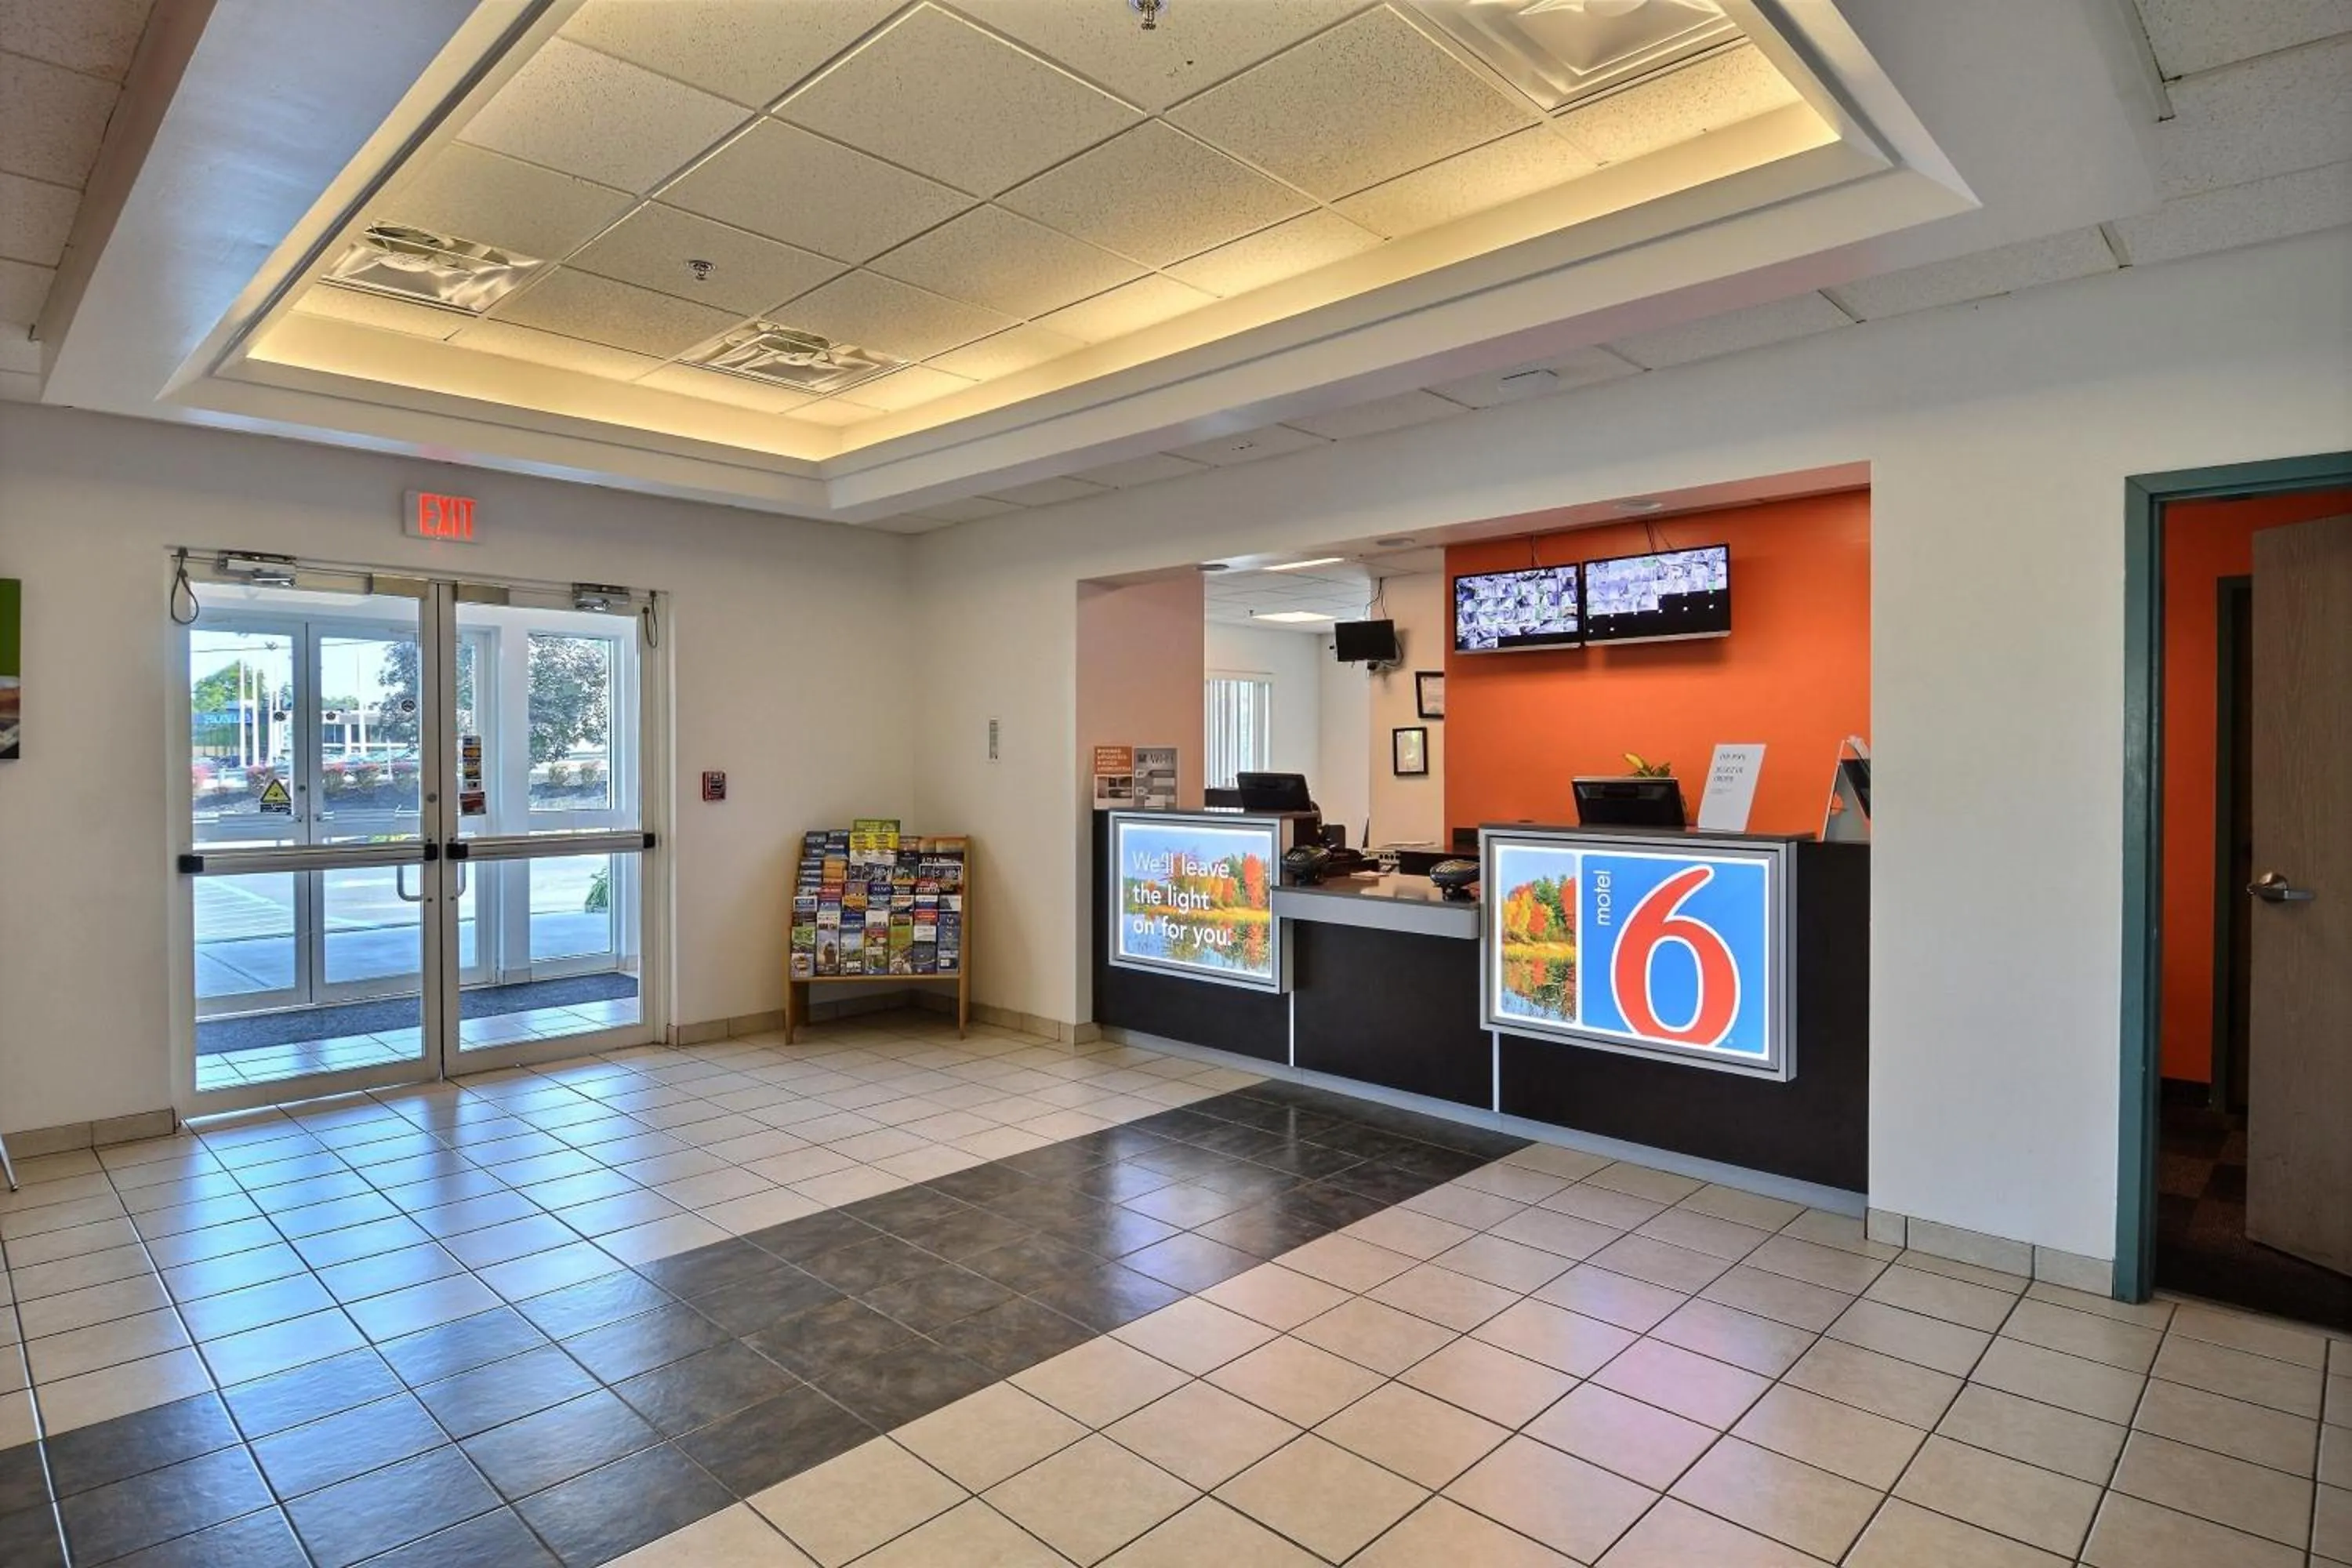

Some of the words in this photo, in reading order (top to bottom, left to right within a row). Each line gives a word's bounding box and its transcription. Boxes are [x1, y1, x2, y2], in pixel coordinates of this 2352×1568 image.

[419, 492, 477, 540] EXIT
[1131, 851, 1174, 875] We'll
[1181, 853, 1230, 877] leave
[1132, 884, 1161, 905] the
[1167, 884, 1210, 914] light
[1593, 869, 1612, 927] motel
[1133, 919, 1155, 935] on
[1161, 916, 1185, 939] for
[1192, 927, 1232, 948] you.
[1610, 864, 1741, 1048] 6
